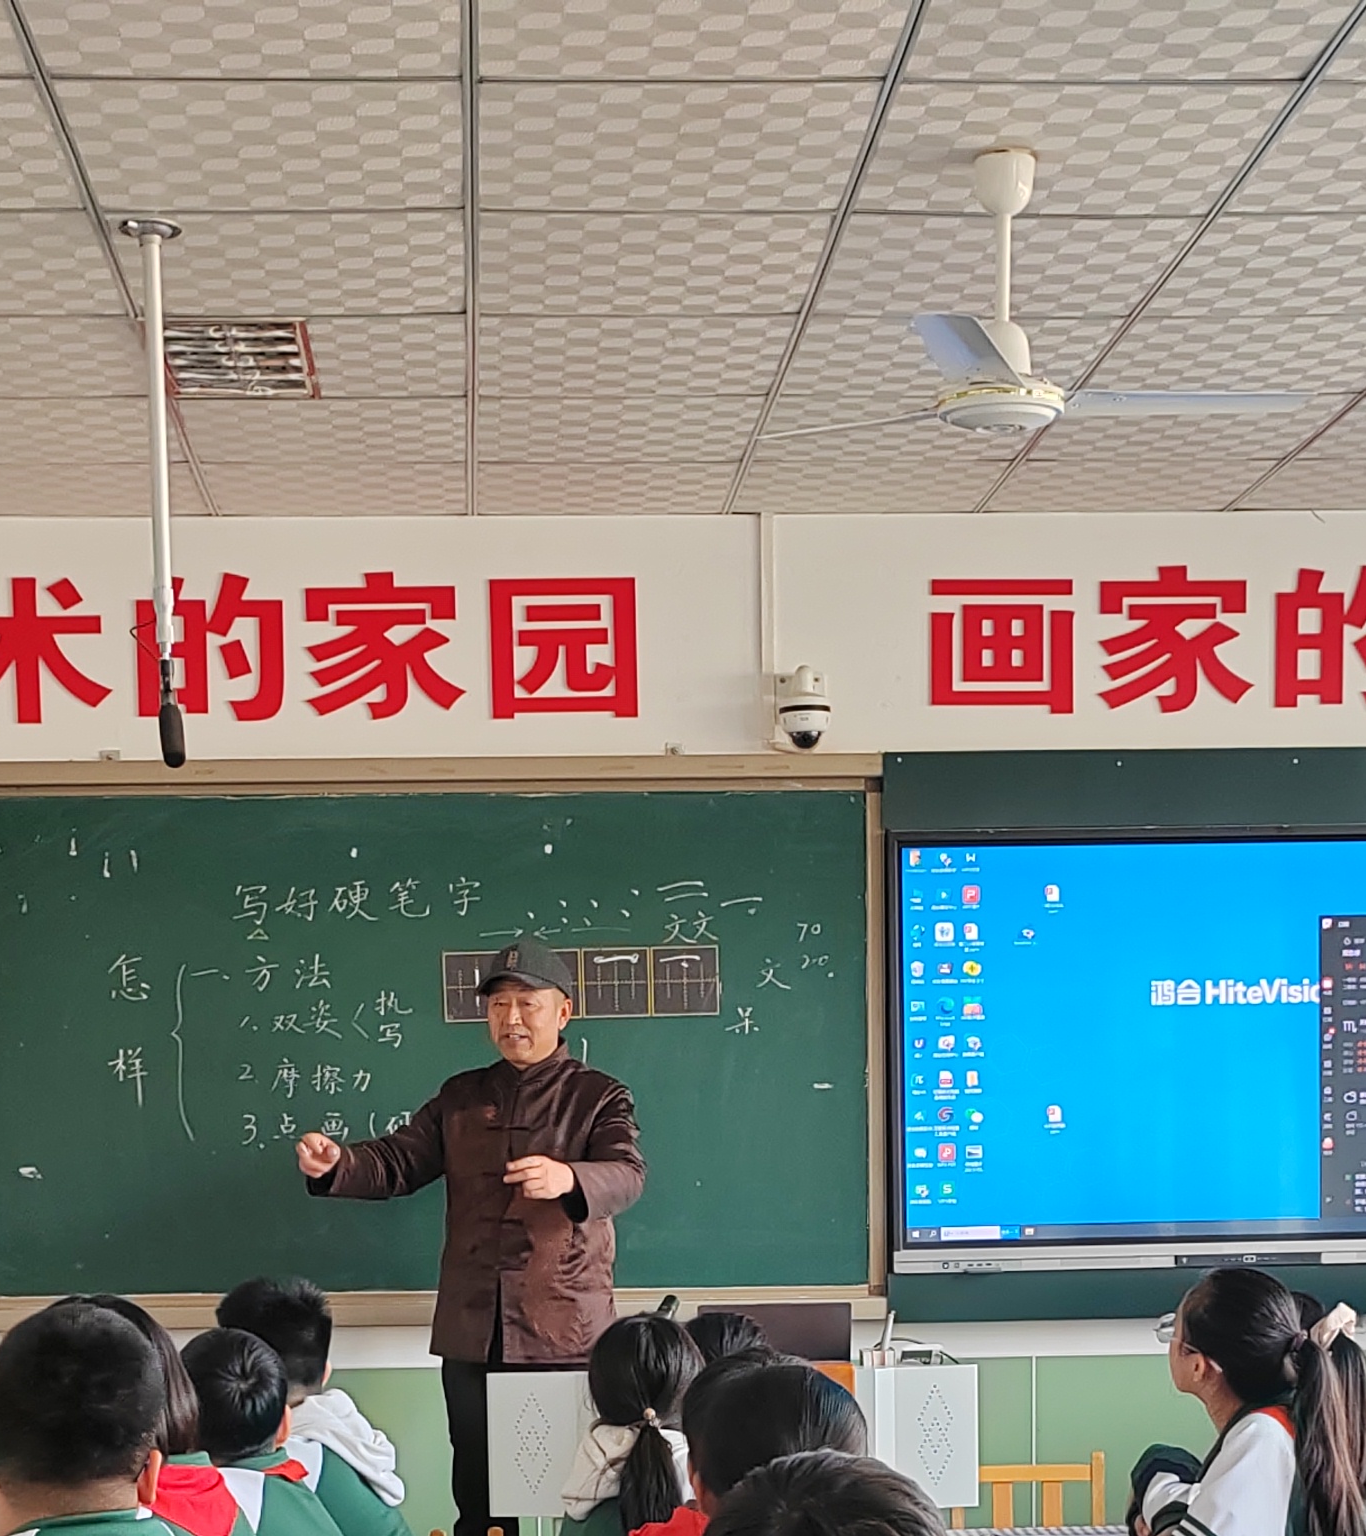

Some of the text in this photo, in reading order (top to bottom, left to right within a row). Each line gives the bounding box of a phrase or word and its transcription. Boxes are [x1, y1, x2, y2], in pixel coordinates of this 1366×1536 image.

[231, 876, 482, 925] 写好硬笔字
[1151, 979, 1201, 1006] 鸿合
